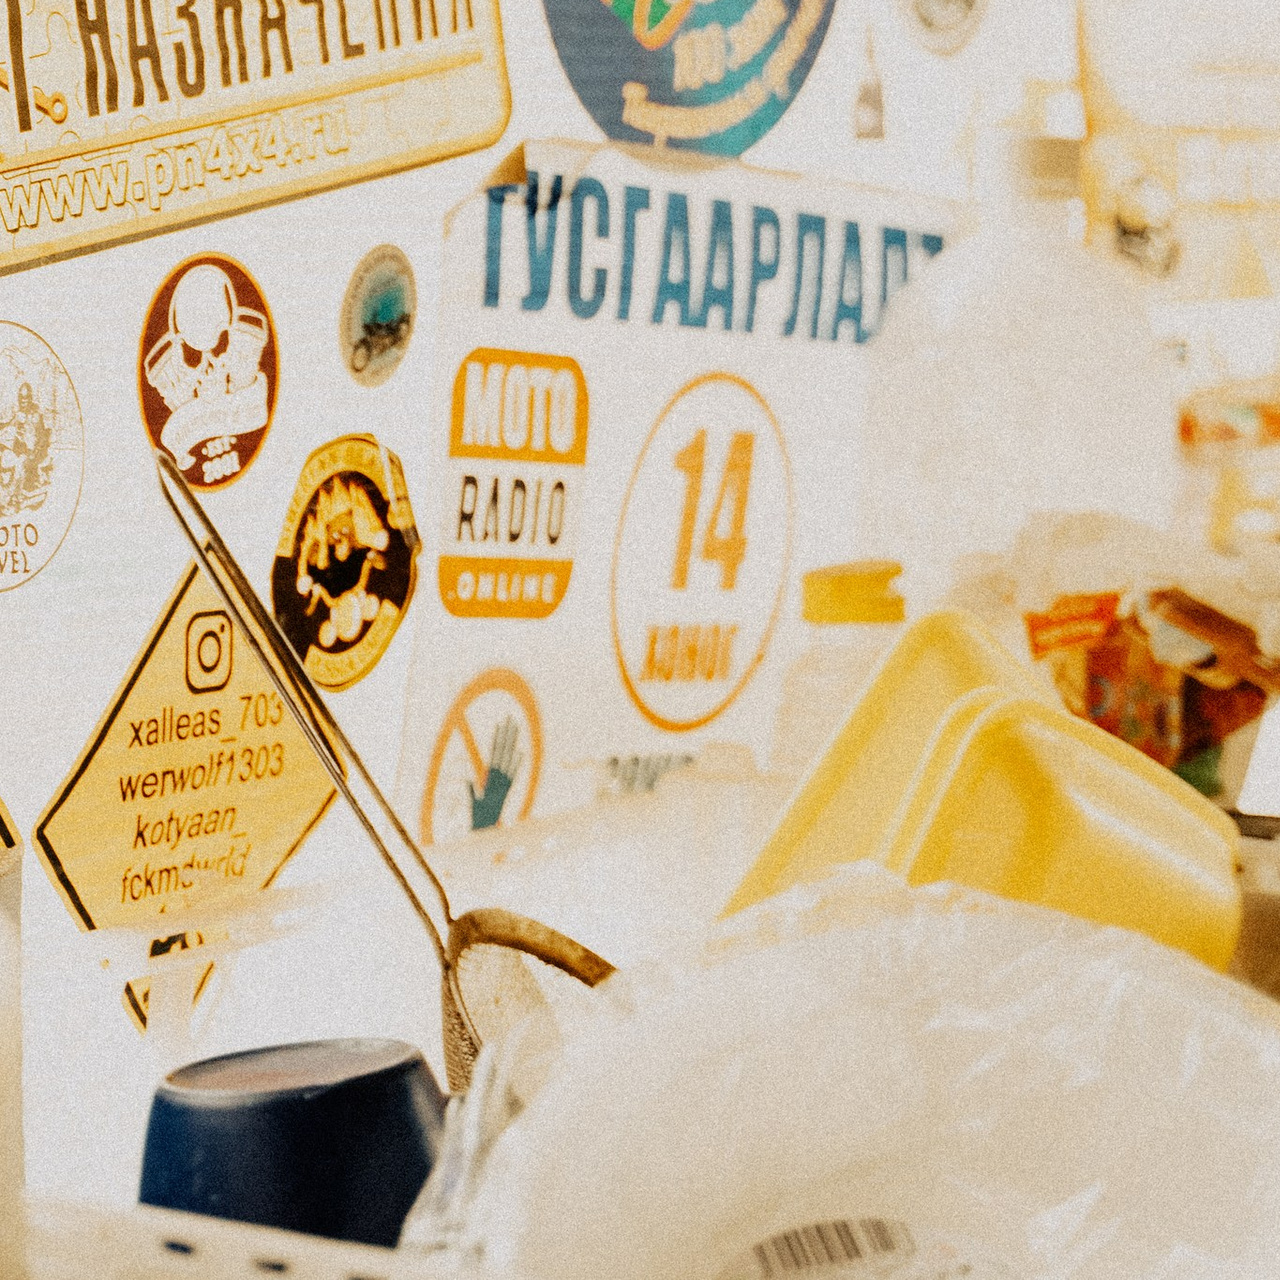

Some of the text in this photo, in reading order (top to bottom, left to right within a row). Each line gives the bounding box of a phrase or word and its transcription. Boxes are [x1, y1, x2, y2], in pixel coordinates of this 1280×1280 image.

[459, 360, 578, 455] MOTO
[455, 474, 568, 547] RADIO
[668, 427, 757, 593] 14
[127, 690, 285, 749] xalleas_703
[118, 742, 286, 803] werwolf1303
[132, 805, 248, 853] kotyaan_
